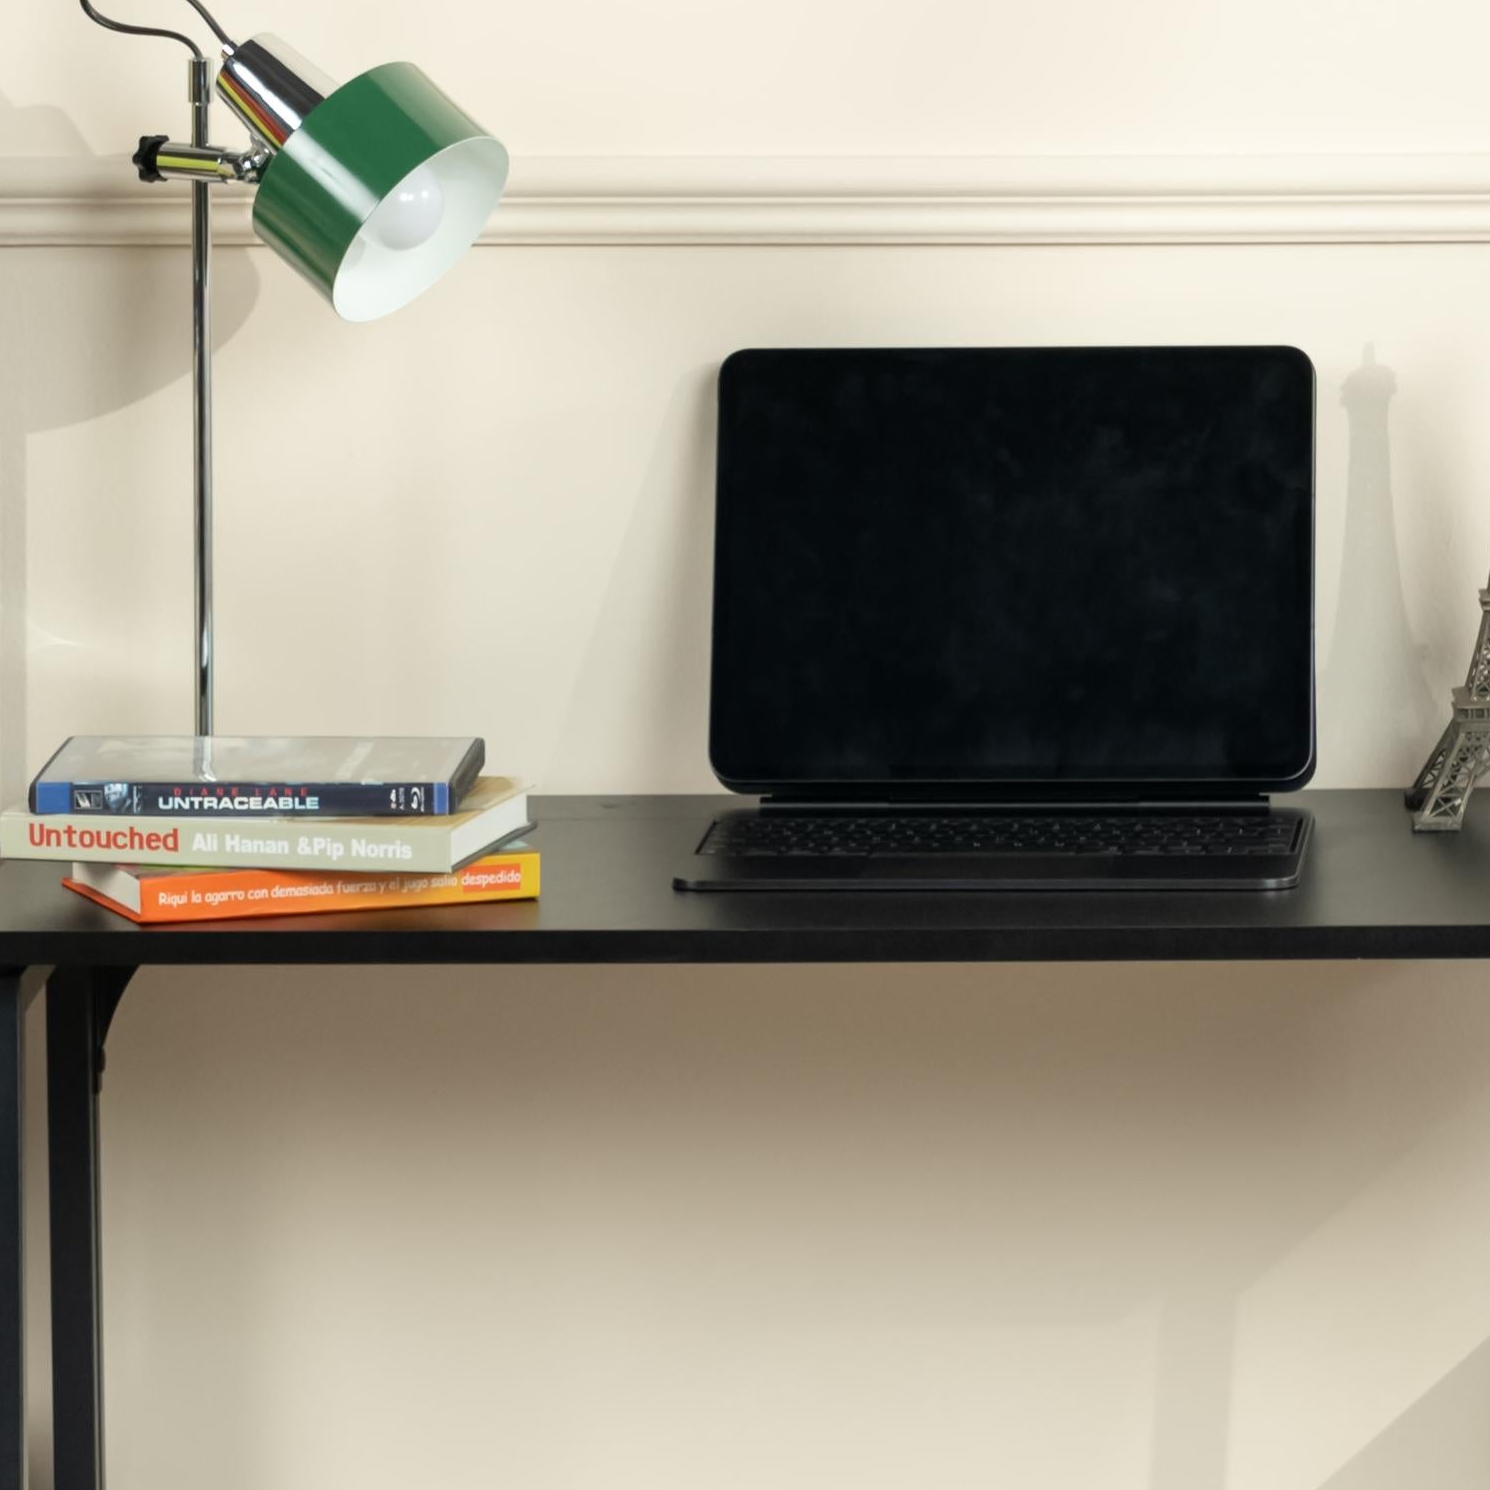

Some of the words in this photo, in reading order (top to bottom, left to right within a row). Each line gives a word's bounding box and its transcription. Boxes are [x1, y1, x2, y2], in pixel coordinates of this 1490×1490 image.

[157, 796, 320, 810] UNTRACEABLE
[28, 822, 179, 853] Untouched
[191, 833, 219, 852] Ali
[225, 834, 290, 855] Hanan
[296, 835, 345, 862] &Pip
[350, 838, 413, 860] Norris
[158, 891, 188, 908] Riqui
[191, 889, 202, 904] la
[247, 888, 269, 900] con
[271, 882, 334, 898] demasiada
[335, 879, 377, 895] fuerza
[378, 881, 387, 894] y
[388, 876, 400, 891] el
[402, 877, 428, 894] jugo
[461, 868, 522, 889] despedido
